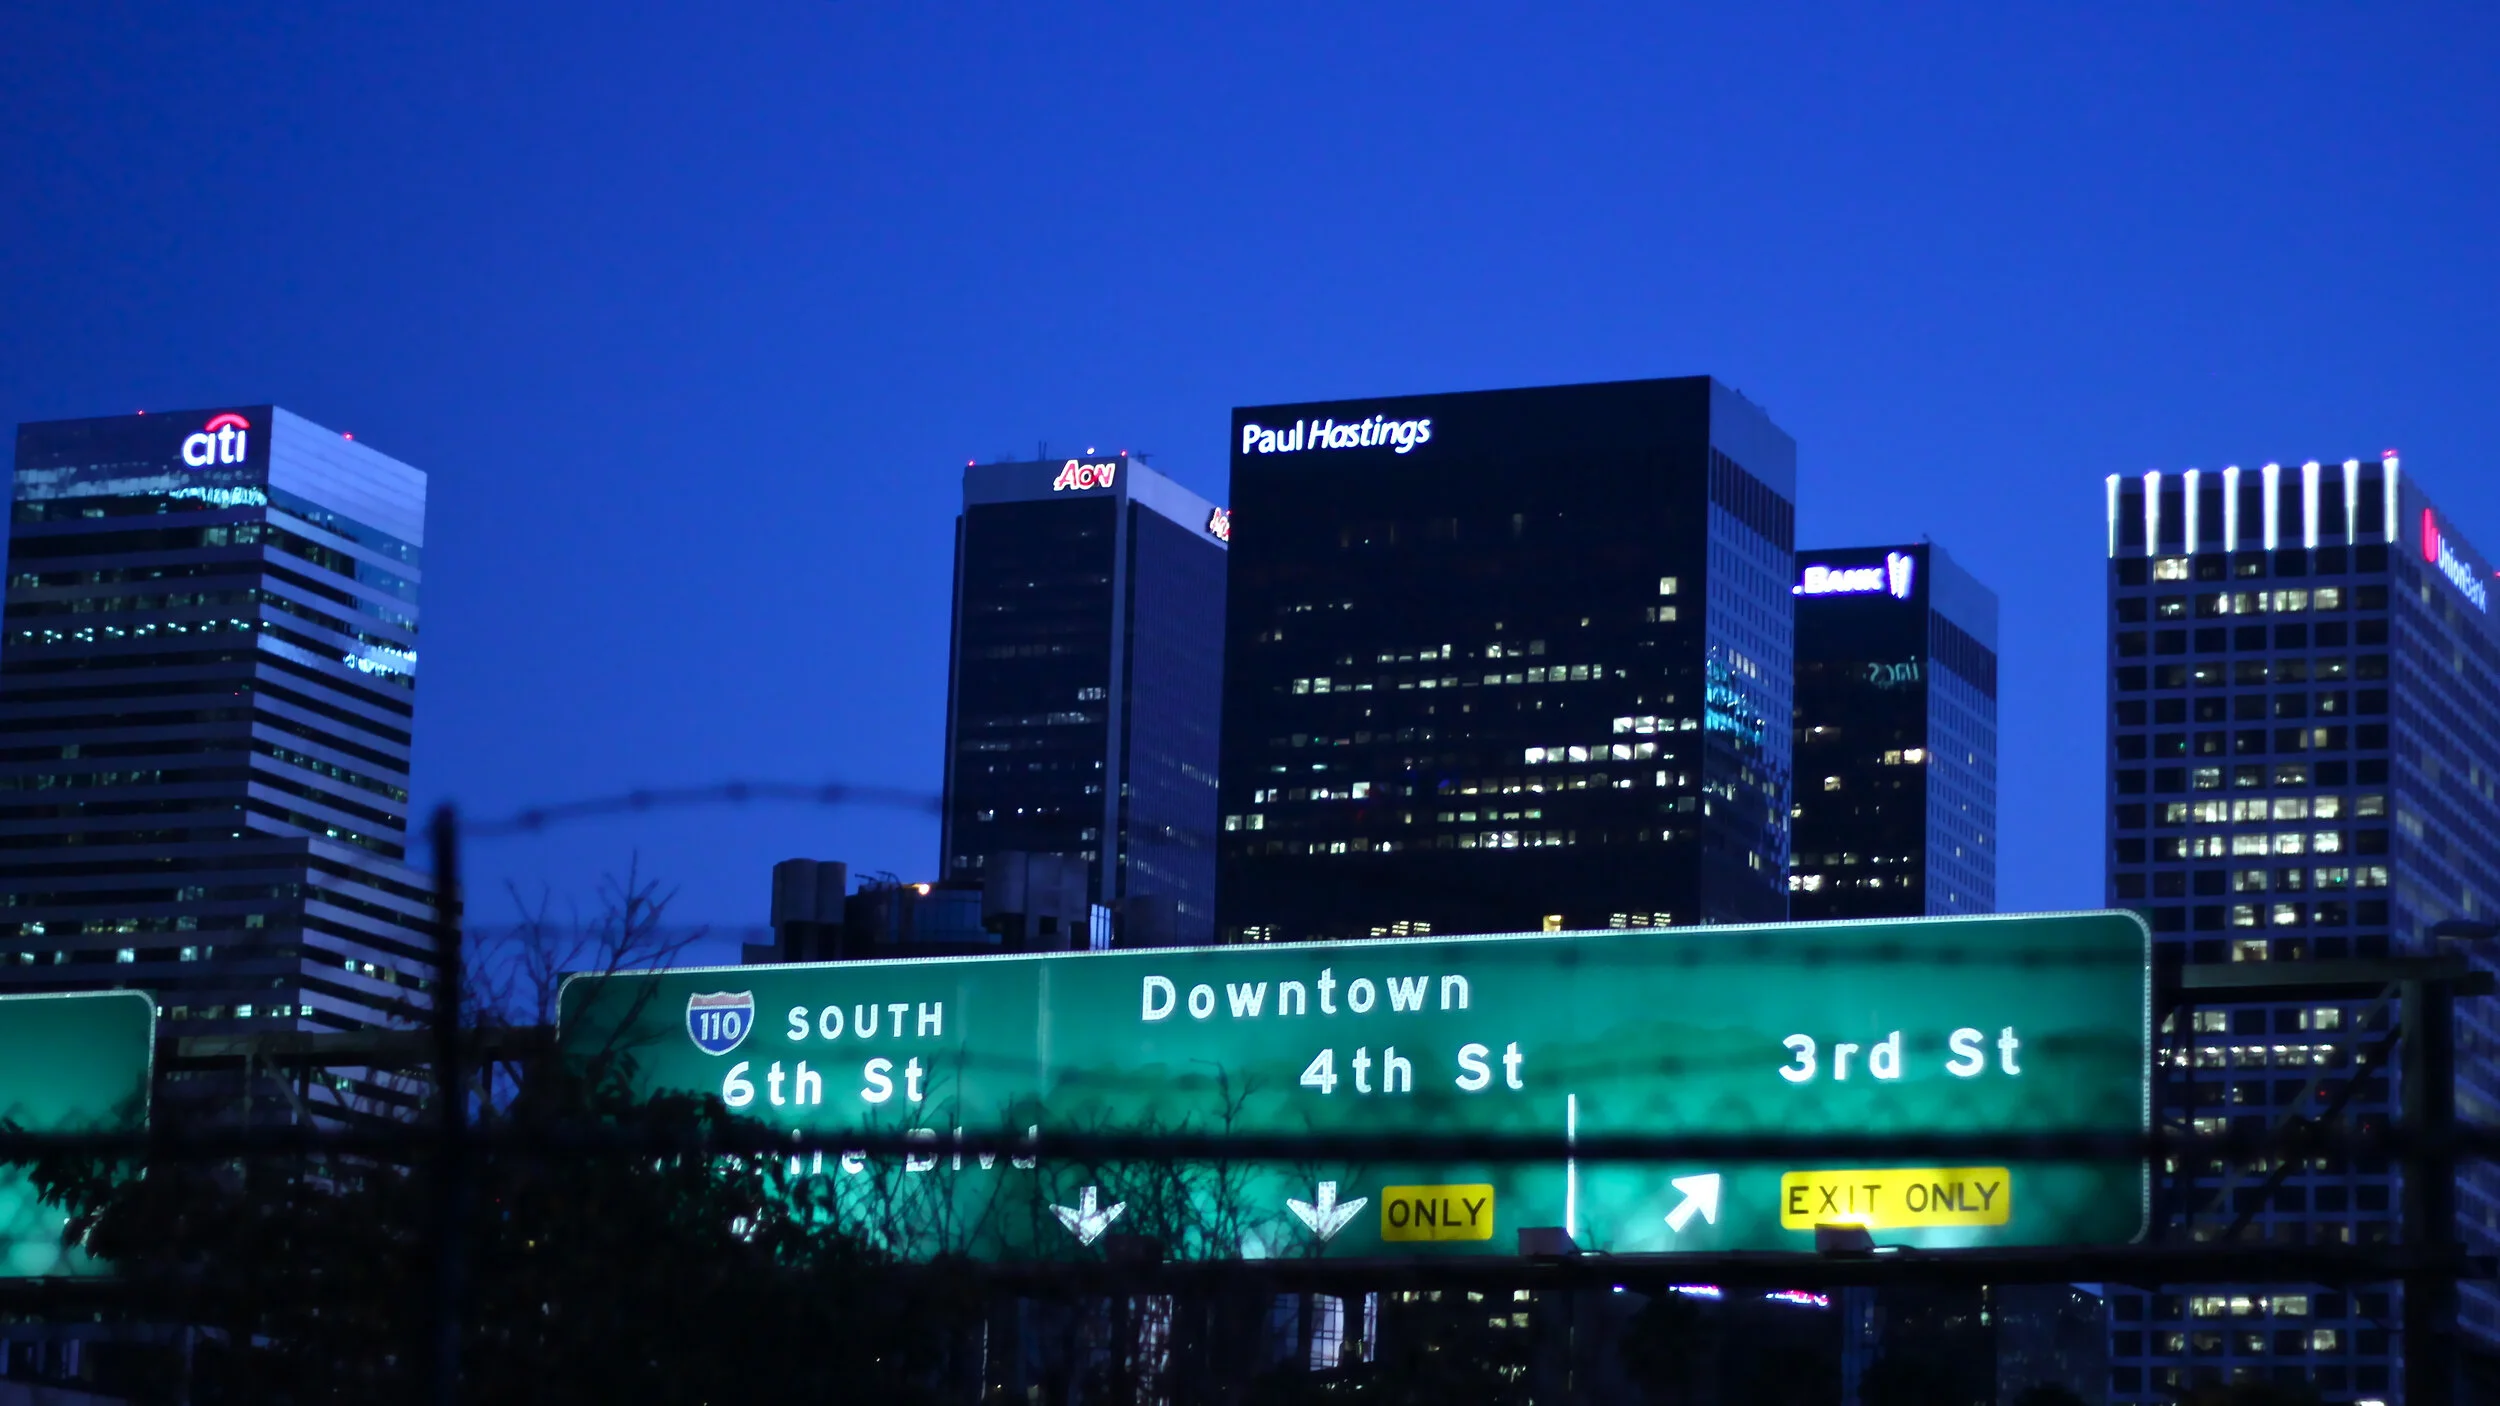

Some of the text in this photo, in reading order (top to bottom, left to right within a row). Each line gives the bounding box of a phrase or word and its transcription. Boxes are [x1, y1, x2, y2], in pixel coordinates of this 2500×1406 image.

[183, 423, 246, 467] citi
[1242, 415, 1432, 455] Paul Hastings
[1141, 967, 1470, 1021] Downtown
[699, 1010, 742, 1042] 110
[787, 1001, 943, 1041] SOUTH
[1300, 1041, 1524, 1094] 4th St
[1779, 1026, 2021, 1083] 3rd St
[722, 1056, 924, 1108] 6th St
[1387, 1197, 1487, 1228] ONLY
[1788, 1180, 2001, 1215] EXIT ONLY
